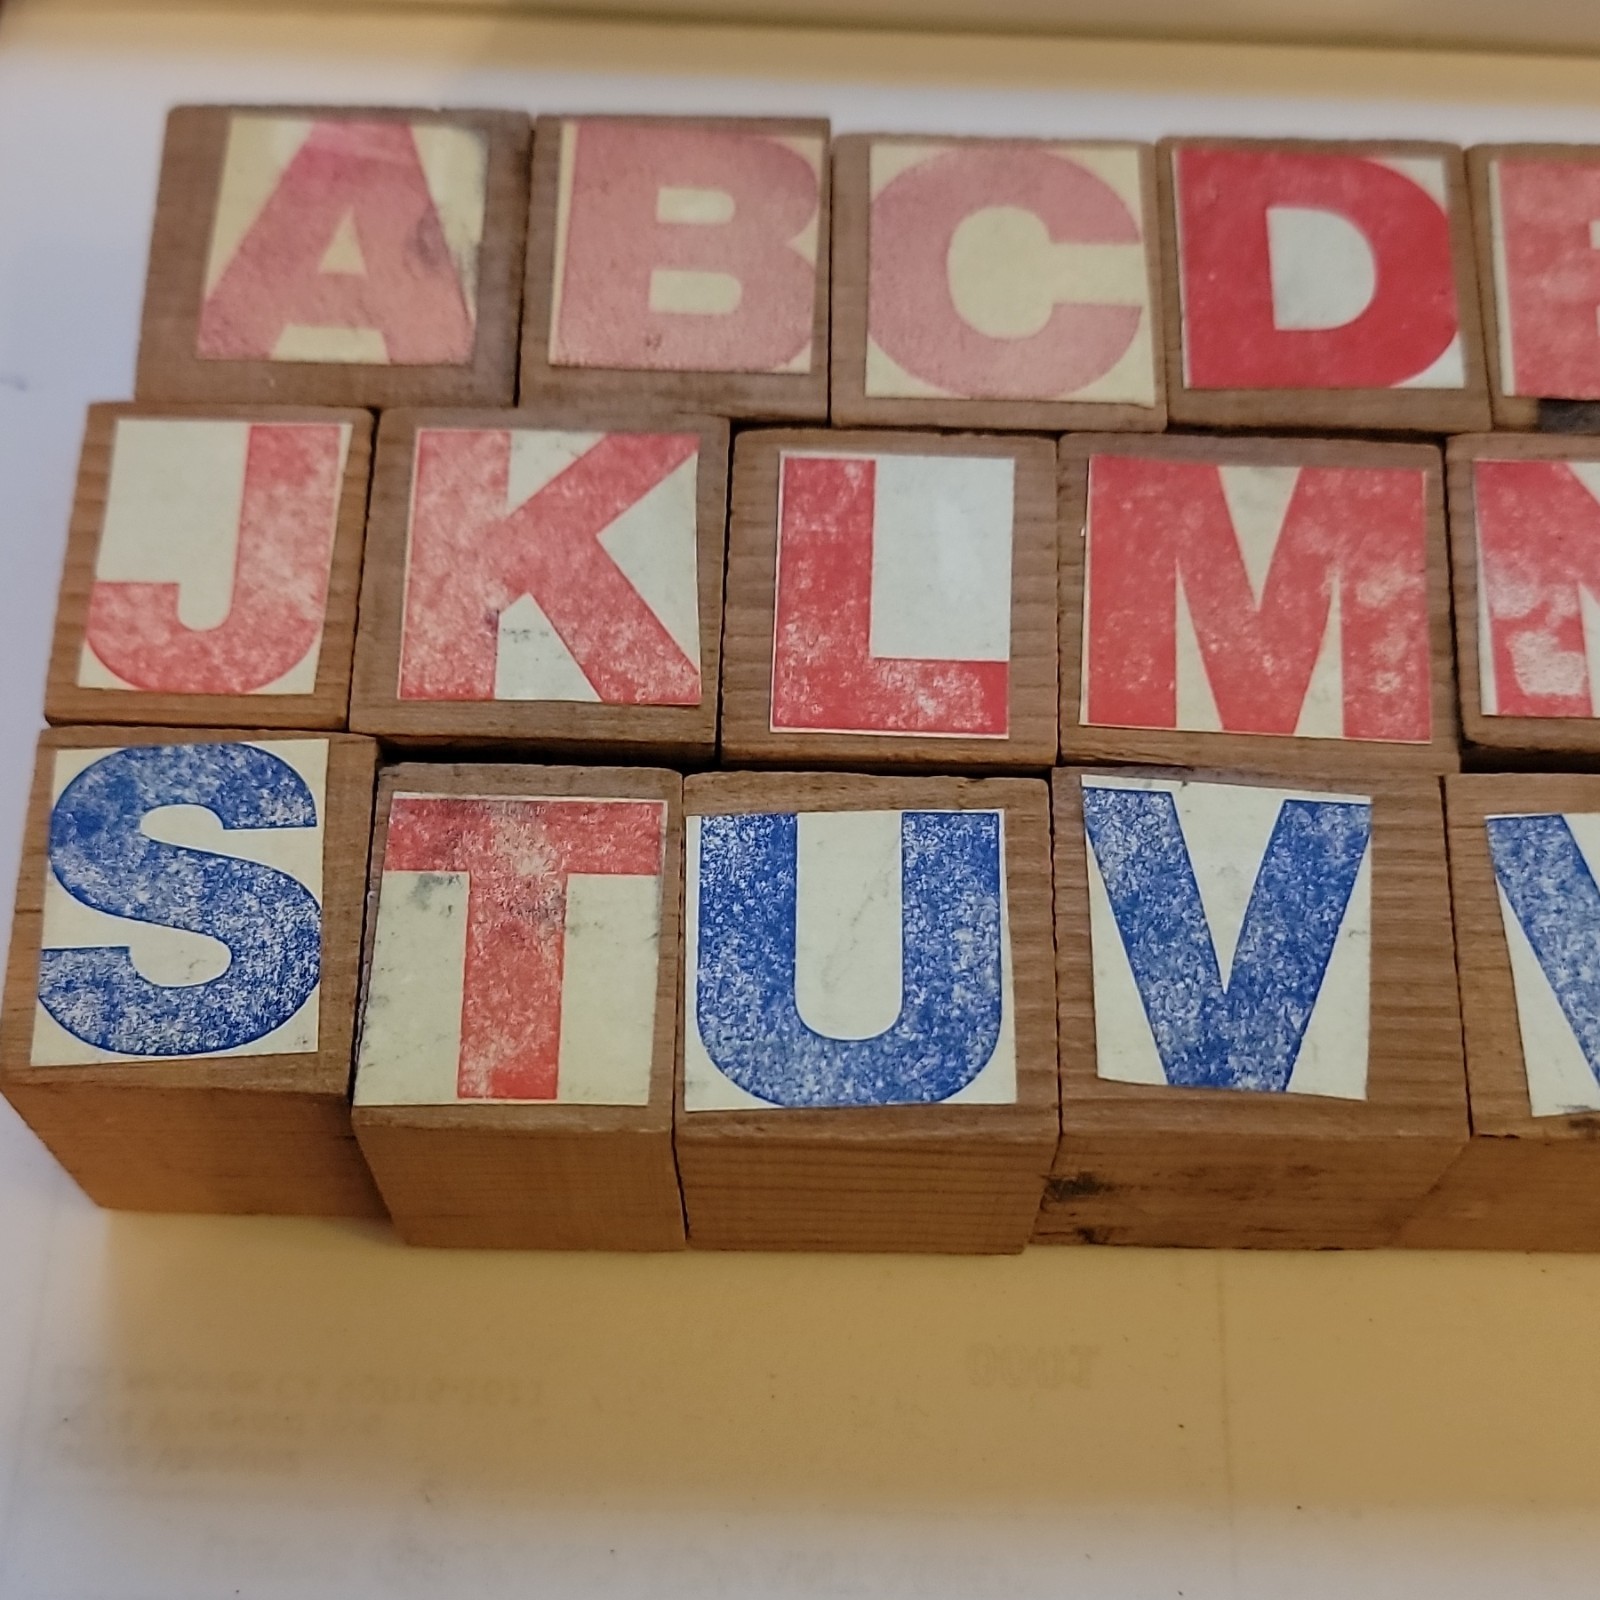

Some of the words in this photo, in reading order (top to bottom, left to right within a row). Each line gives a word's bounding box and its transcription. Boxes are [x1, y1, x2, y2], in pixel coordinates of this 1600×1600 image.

[198, 120, 475, 365] A
[556, 122, 816, 372] B
[868, 145, 1143, 400] C
[1180, 149, 1458, 389] D
[86, 424, 340, 694] J
[398, 429, 701, 705] K
[773, 457, 1009, 736] L
[1087, 455, 1432, 742] M
[38, 742, 321, 1057] S
[385, 800, 667, 1100] T
[697, 811, 1002, 1107] U
[1082, 788, 1372, 1092] V
